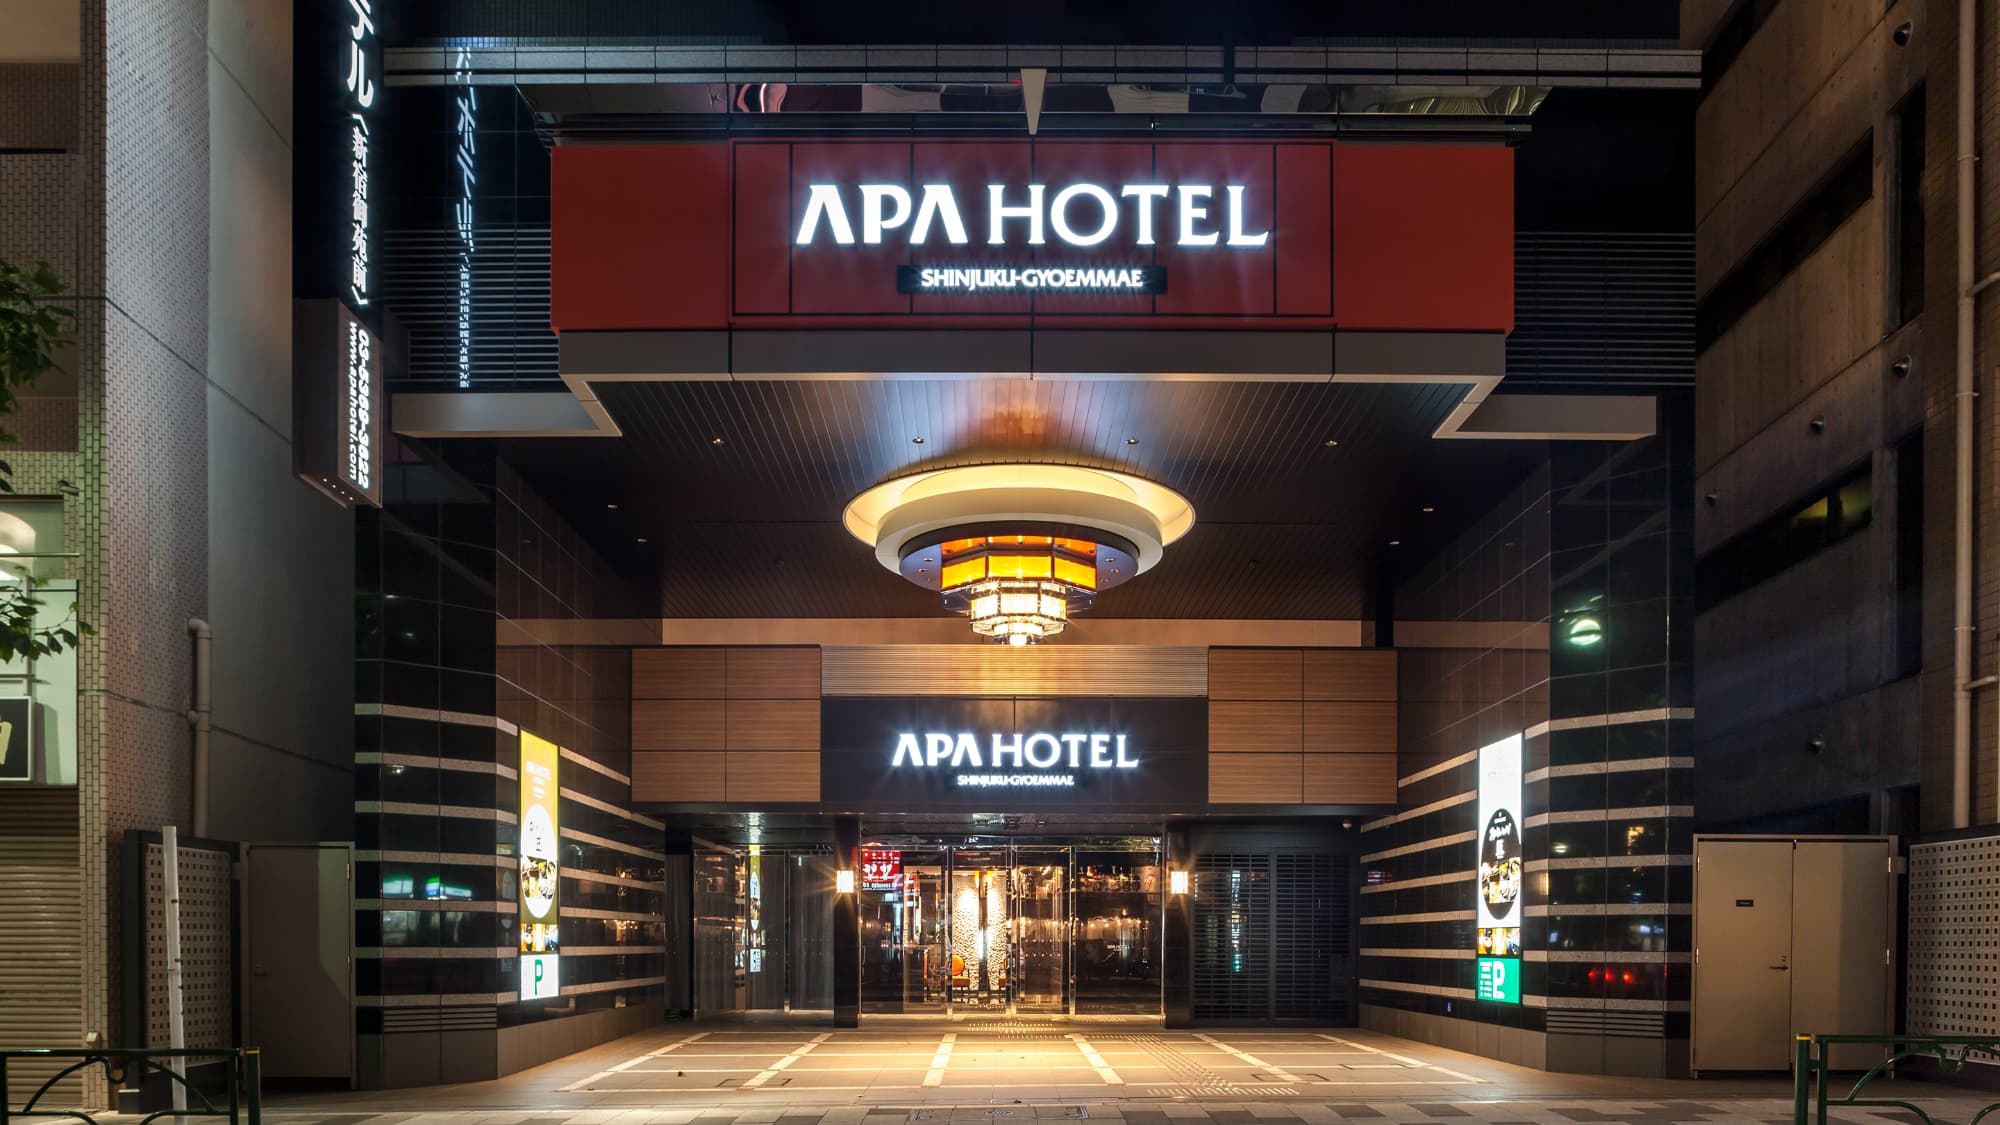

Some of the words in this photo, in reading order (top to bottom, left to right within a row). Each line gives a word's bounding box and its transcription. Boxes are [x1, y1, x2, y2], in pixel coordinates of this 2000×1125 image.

[796, 184, 969, 245] APA
[987, 183, 1270, 246] HOTEL
[921, 268, 1144, 292] SHINJUKU-GYOEMMAE
[348, 321, 358, 481] www.apahotel.com
[891, 733, 983, 767] APA
[991, 733, 1140, 768] HOTEL
[957, 774, 1075, 788] SHINJUKU-GYOEMMAE
[534, 959, 544, 996] P
